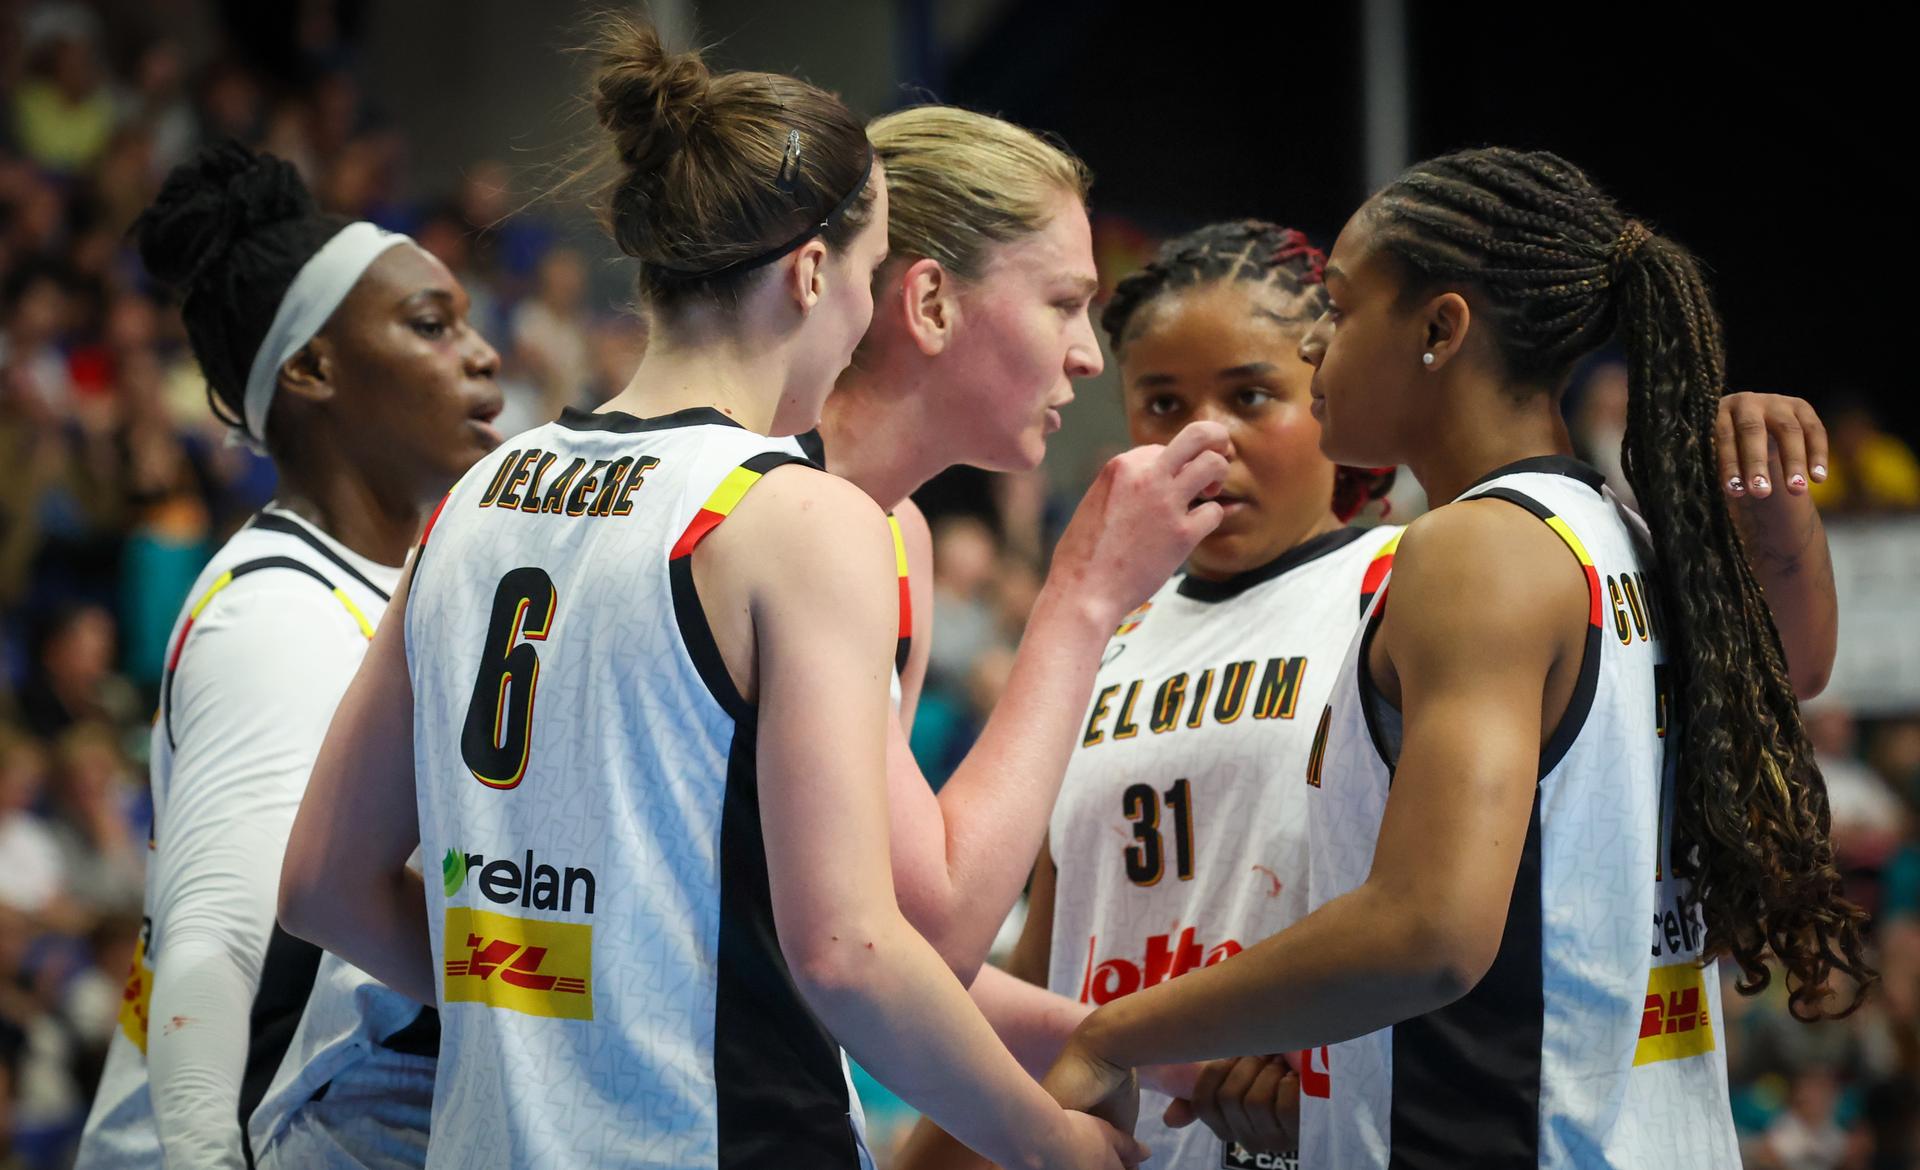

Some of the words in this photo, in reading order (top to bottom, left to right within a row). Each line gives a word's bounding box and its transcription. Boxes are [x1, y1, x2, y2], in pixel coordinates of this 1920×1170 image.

[479, 448, 660, 517] DELAERE
[461, 567, 557, 790] 6
[1083, 656, 1307, 748] ELGIUM
[1122, 778, 1195, 887] 31
